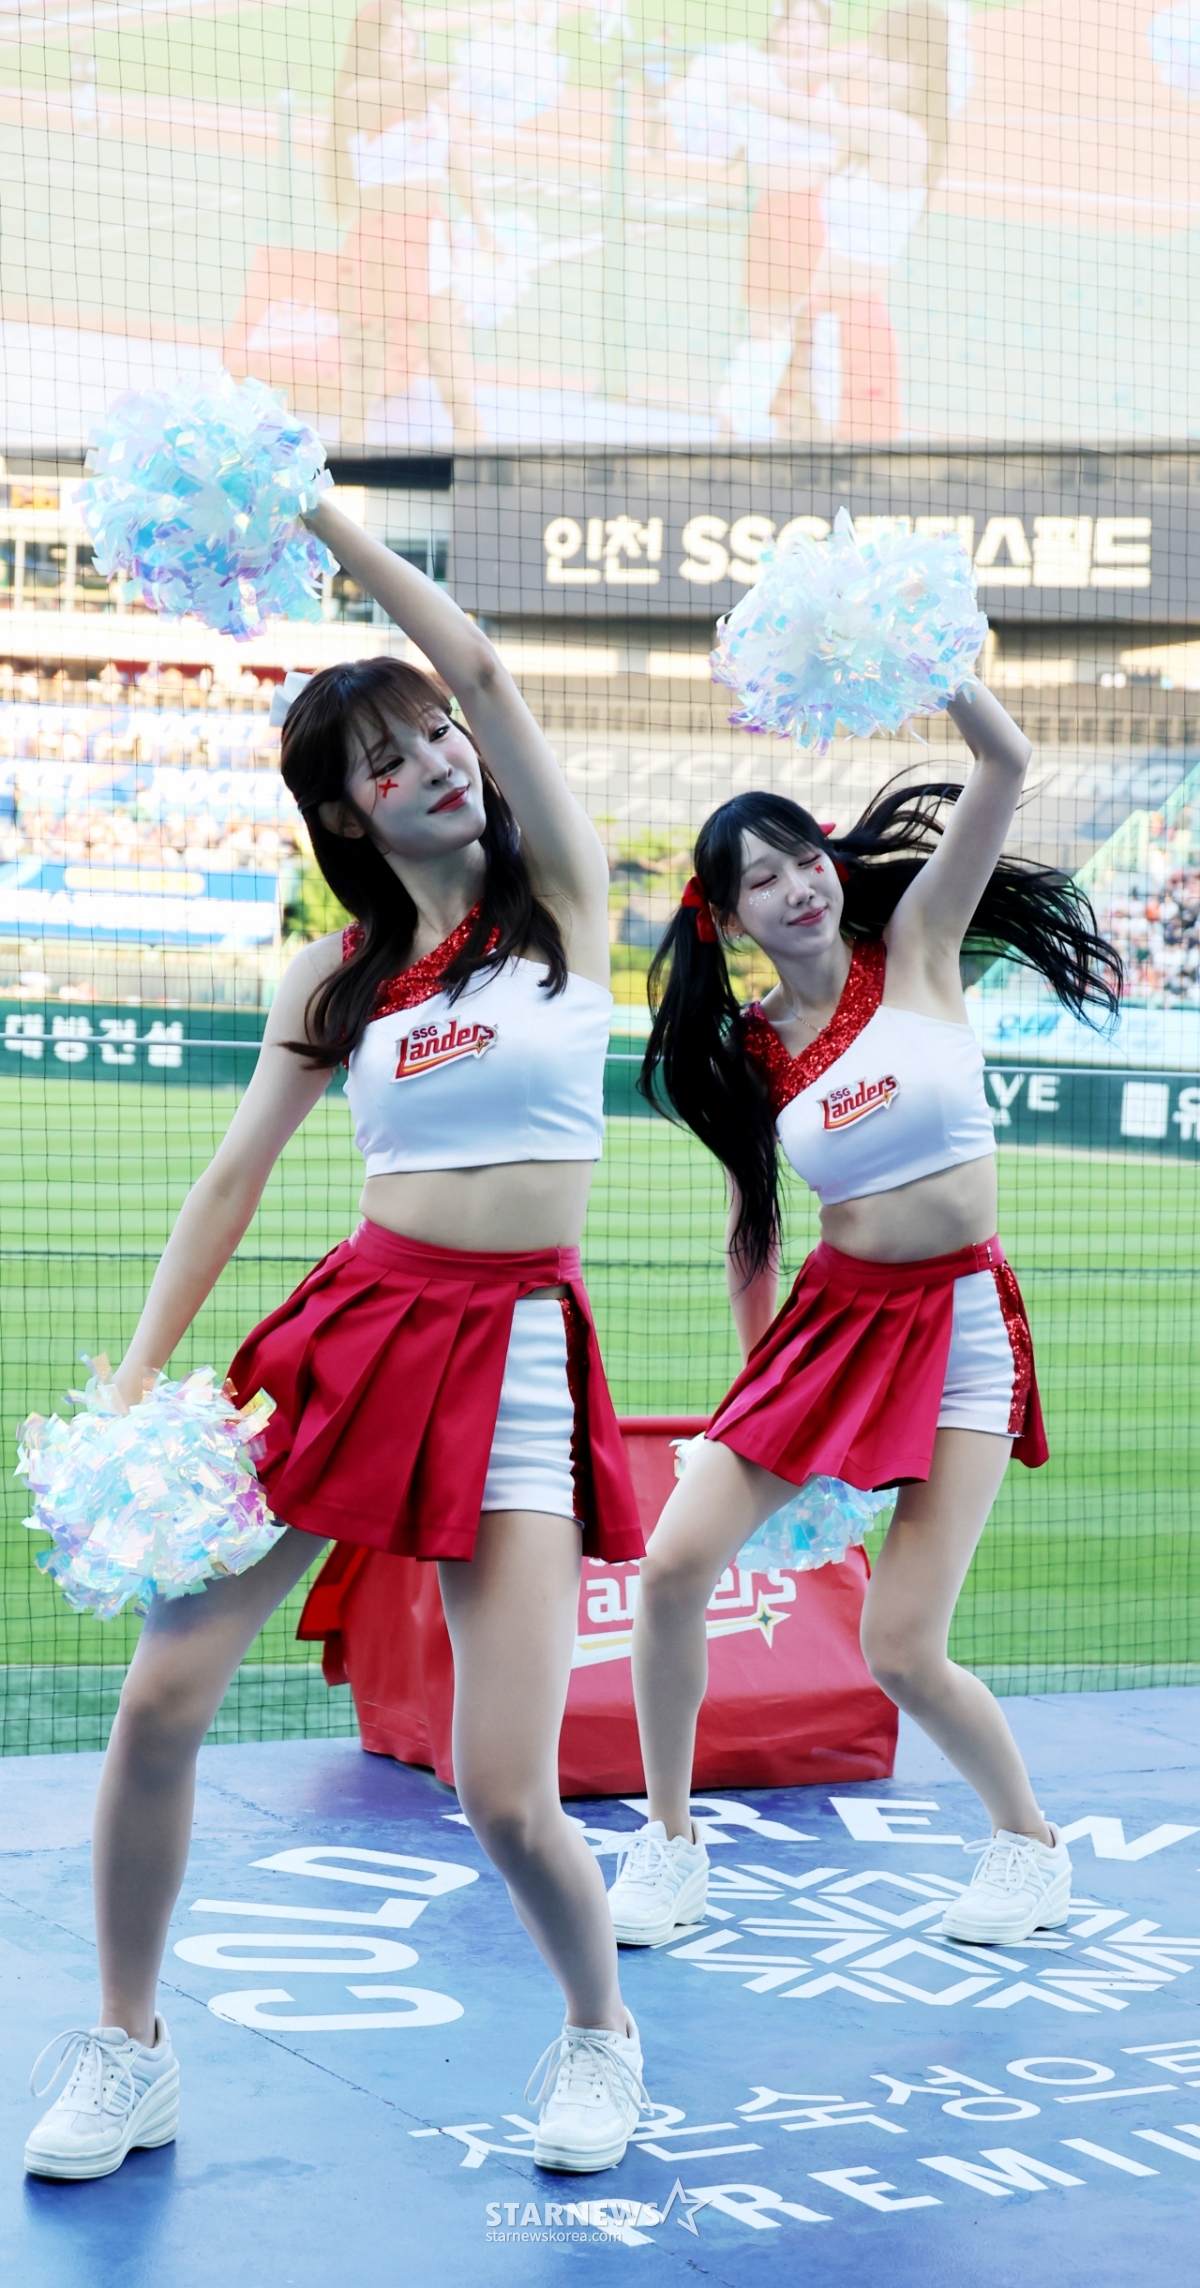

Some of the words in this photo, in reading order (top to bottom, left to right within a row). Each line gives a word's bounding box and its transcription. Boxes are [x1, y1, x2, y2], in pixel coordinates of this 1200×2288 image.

[543, 514, 663, 585] 인천
[4, 1013, 184, 1068] 대방건설
[395, 1019, 495, 1079] Landers
[412, 1025, 438, 1040] SSG
[821, 1075, 897, 1130] Landers
[830, 1087, 851, 1102] SSG
[173, 1845, 480, 2032] COLD
